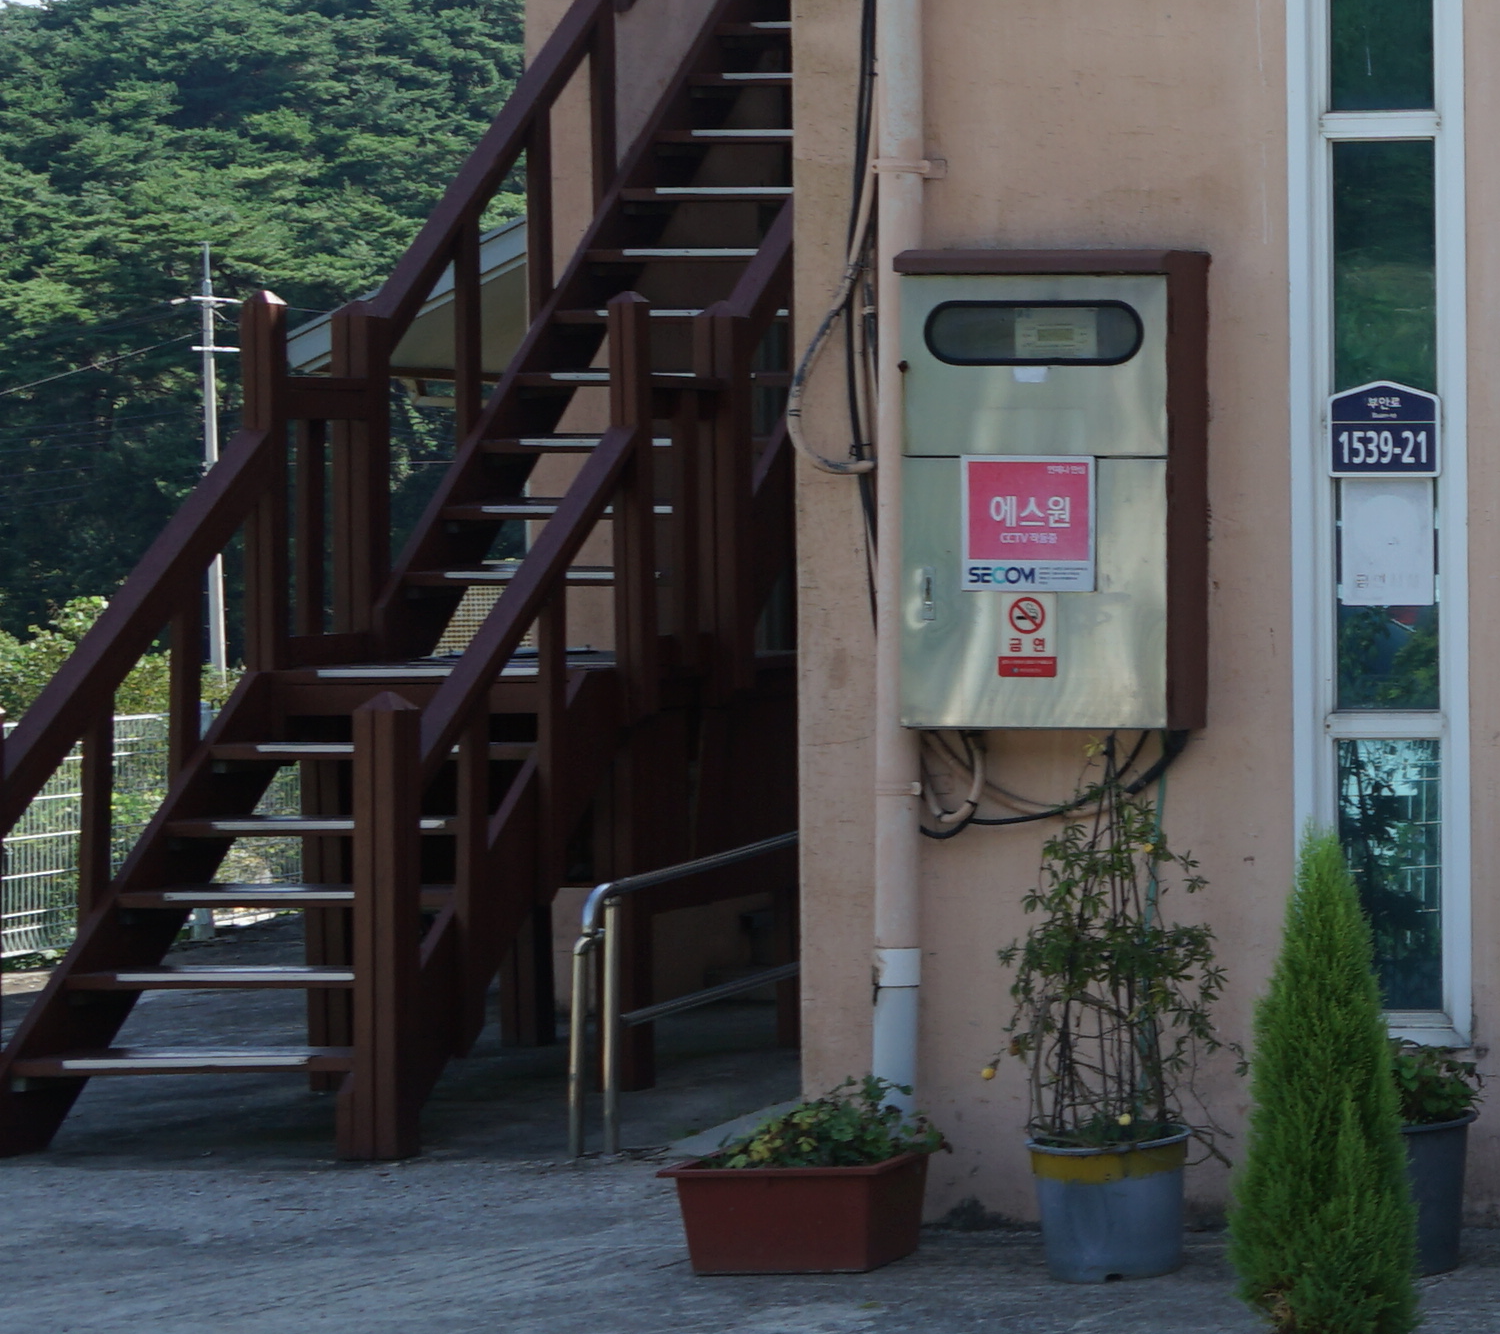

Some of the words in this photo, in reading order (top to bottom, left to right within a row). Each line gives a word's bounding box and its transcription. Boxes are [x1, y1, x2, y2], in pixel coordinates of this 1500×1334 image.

[1367, 396, 1402, 410] 부안로
[1338, 430, 1428, 464] 1539-21
[989, 495, 1071, 528] 에스원
[1000, 532, 1029, 543] CCTV
[968, 566, 1036, 584] SECOM
